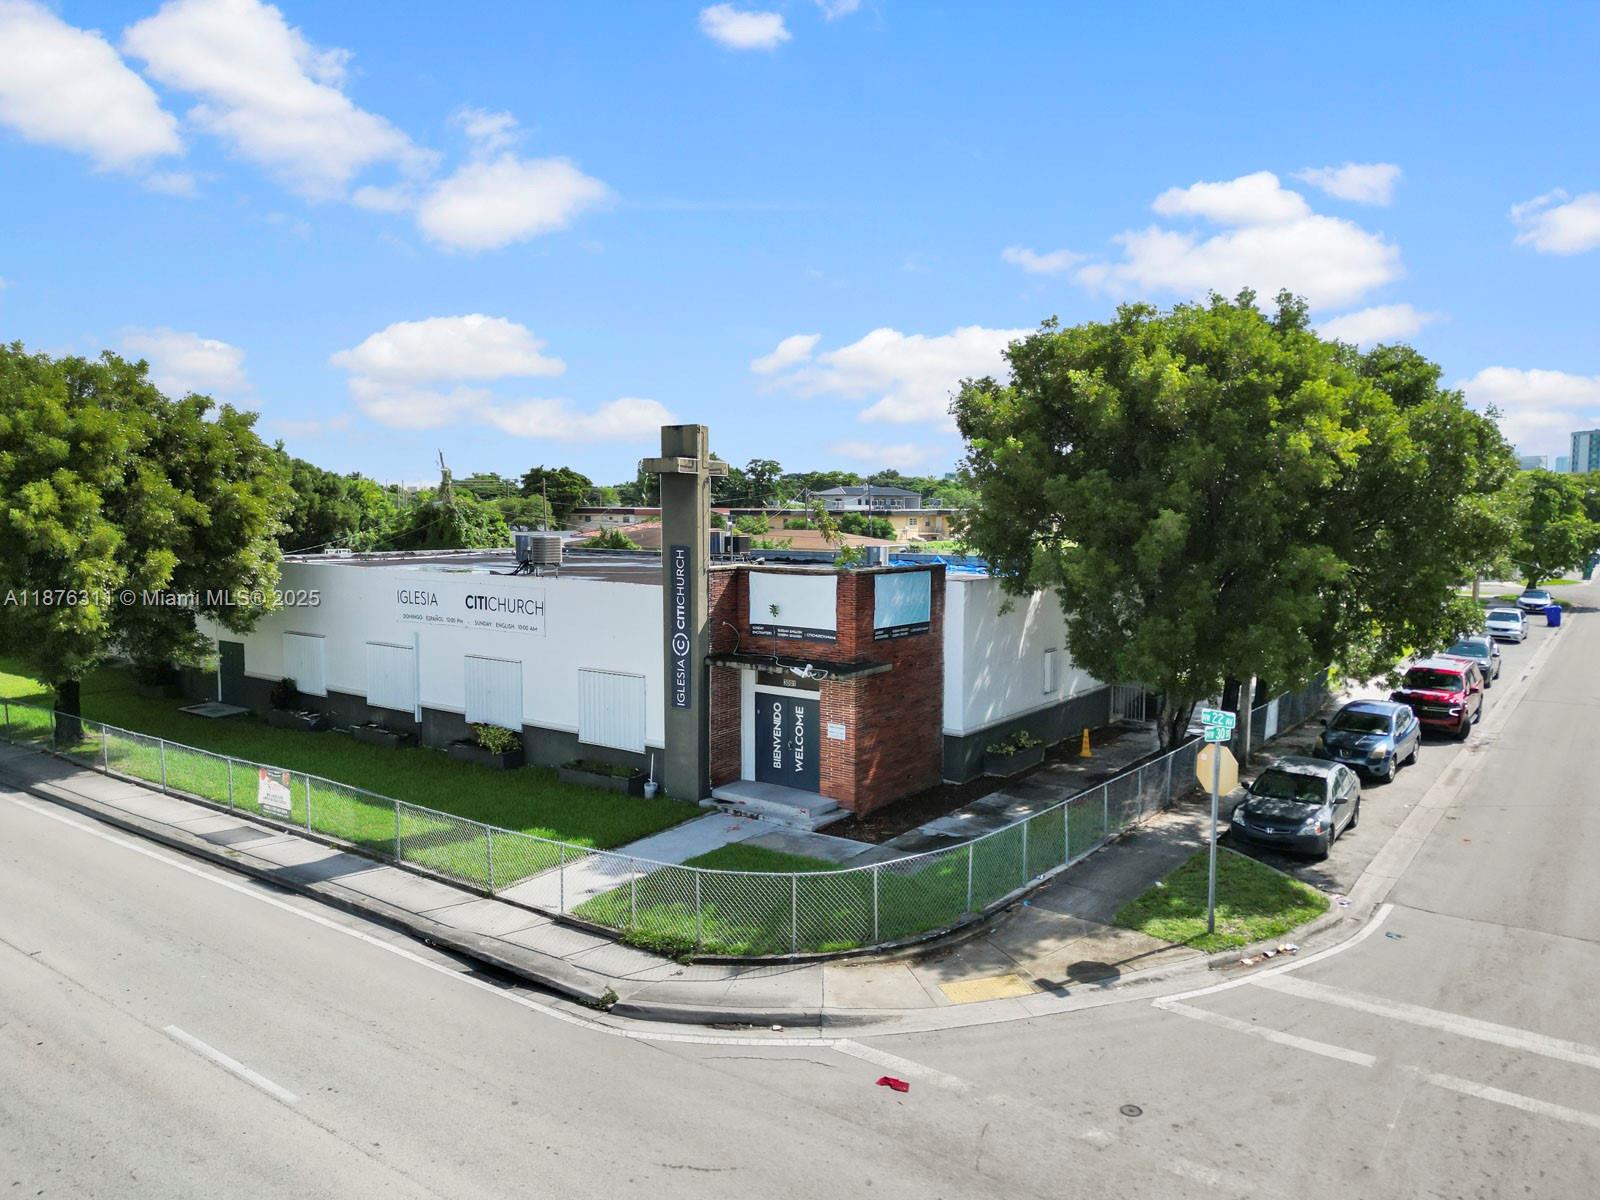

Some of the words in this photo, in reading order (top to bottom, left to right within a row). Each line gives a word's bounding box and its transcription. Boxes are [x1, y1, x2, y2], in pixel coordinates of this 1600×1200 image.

[396, 589, 438, 606] IGLESIA
[465, 594, 544, 616] CITICHURCH
[676, 549, 685, 630] CITICHURCH
[676, 659, 685, 706] IGLESIA
[773, 702, 782, 769] BIENVENIDO
[795, 705, 804, 772] WELCOME
[1212, 712, 1224, 725] 22
[1215, 727, 1225, 739] 30
